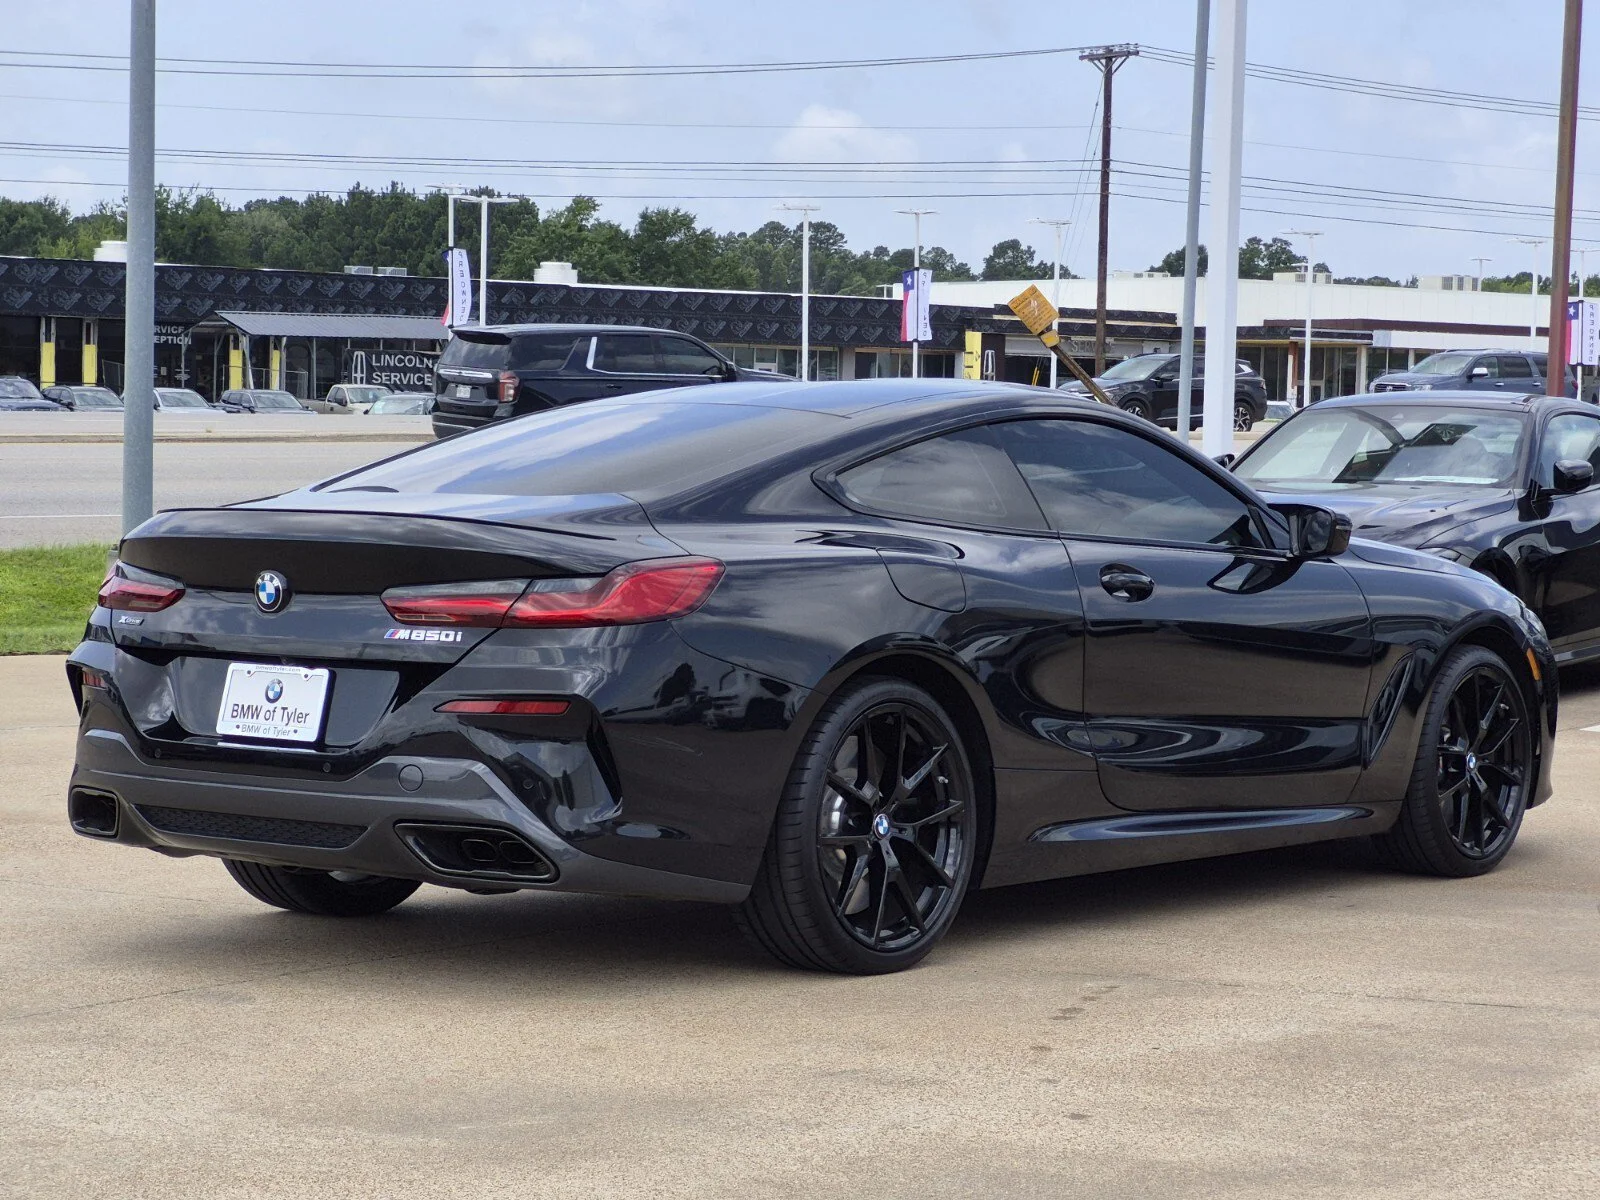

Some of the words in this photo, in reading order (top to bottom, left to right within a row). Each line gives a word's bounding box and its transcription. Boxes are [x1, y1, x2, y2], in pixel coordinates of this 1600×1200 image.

[154, 325, 185, 334] RVICE
[154, 335, 192, 345] EPTION
[372, 354, 433, 369] LINCOLN
[372, 371, 433, 386] SERVICE
[384, 628, 463, 642] M850i
[230, 703, 263, 720] BMW
[263, 706, 278, 721] of
[280, 706, 310, 726] Tyler
[241, 723, 261, 733] BMW
[262, 725, 272, 735] of
[273, 726, 291, 737] Tyler
